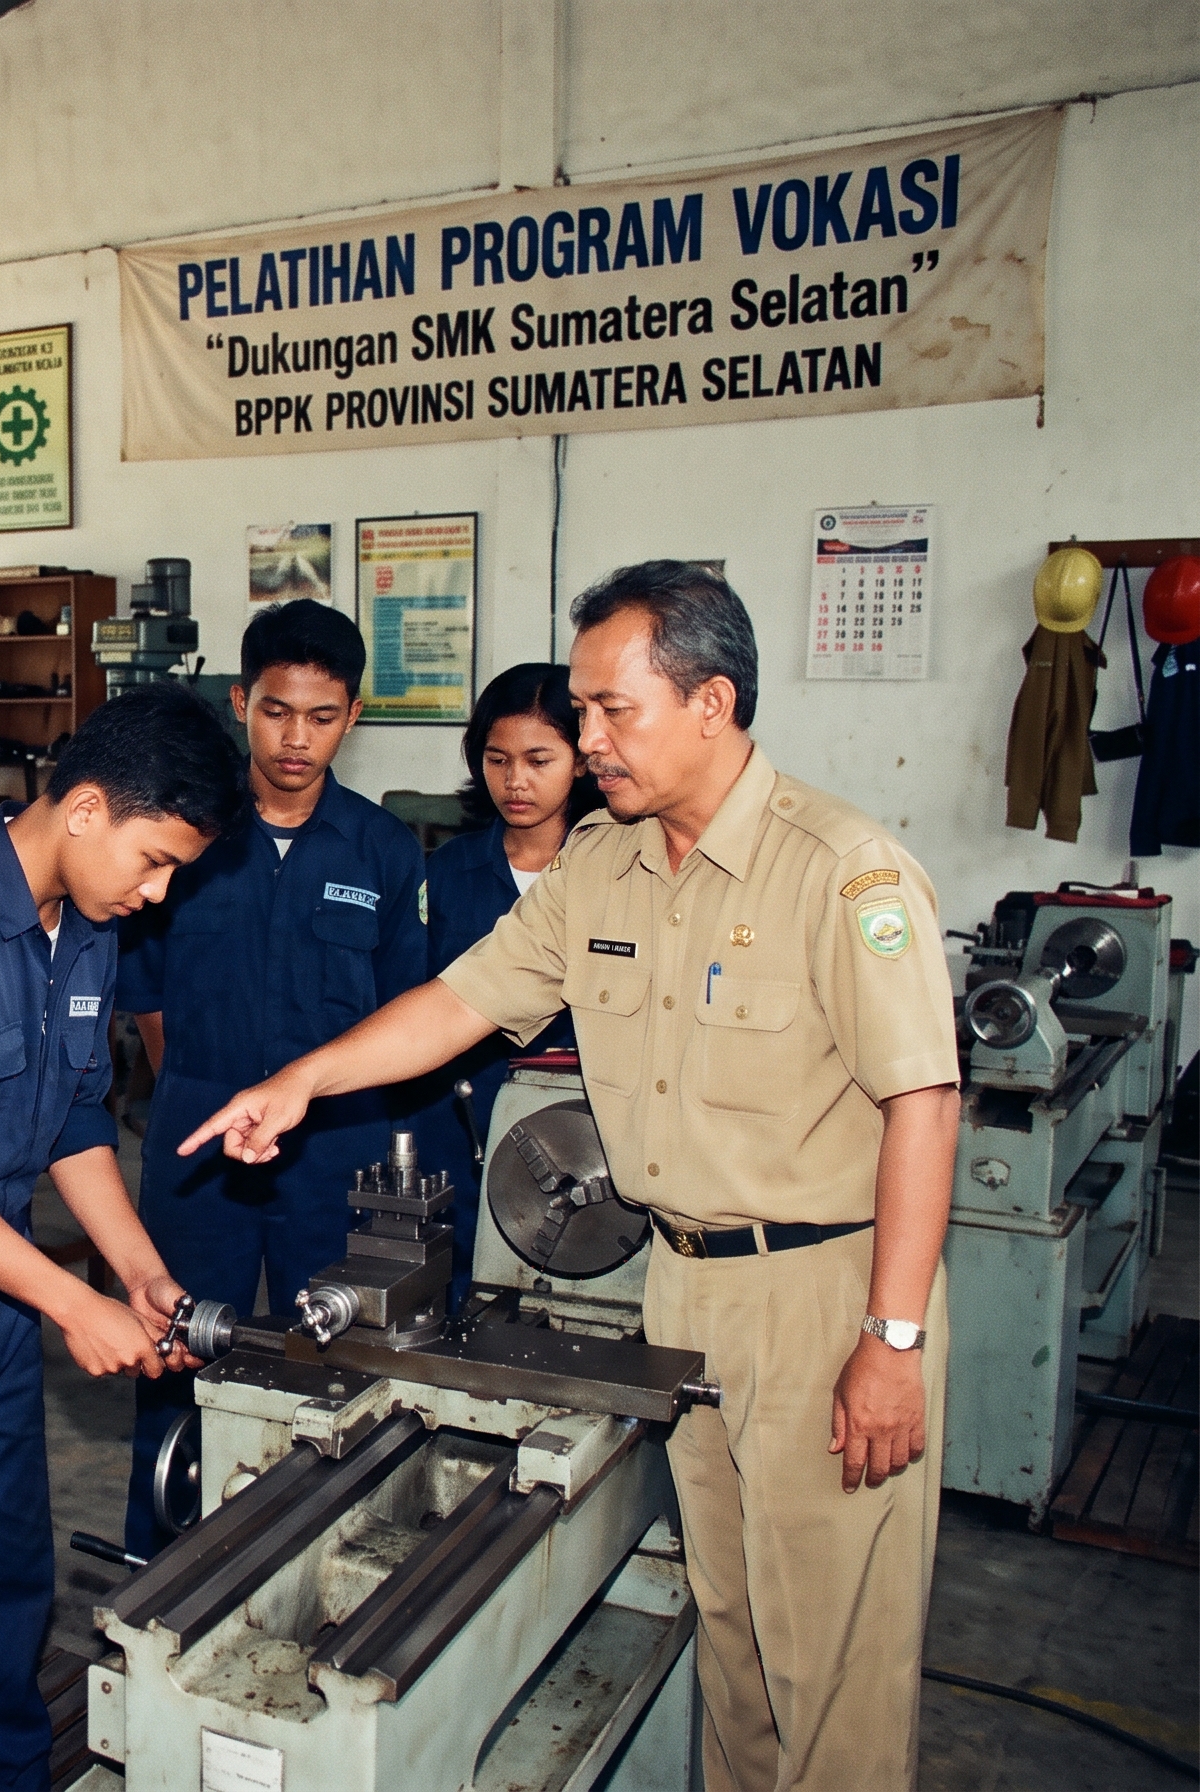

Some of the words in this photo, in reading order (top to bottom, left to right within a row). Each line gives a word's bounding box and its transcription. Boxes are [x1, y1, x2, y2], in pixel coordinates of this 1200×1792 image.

[178, 233, 415, 320] PELATIHAN
[441, 193, 703, 290] PROGRAM
[732, 153, 961, 255] VOKASI
[206, 331, 397, 380] “Dukungan
[412, 307, 495, 361] SMK
[511, 295, 713, 351] Sumatera
[730, 249, 939, 330] Selatan”
[235, 395, 313, 436] BPPK
[326, 380, 474, 431] PROVINSI
[488, 362, 687, 418] SUMATERA
[702, 341, 881, 402] SELATAN
